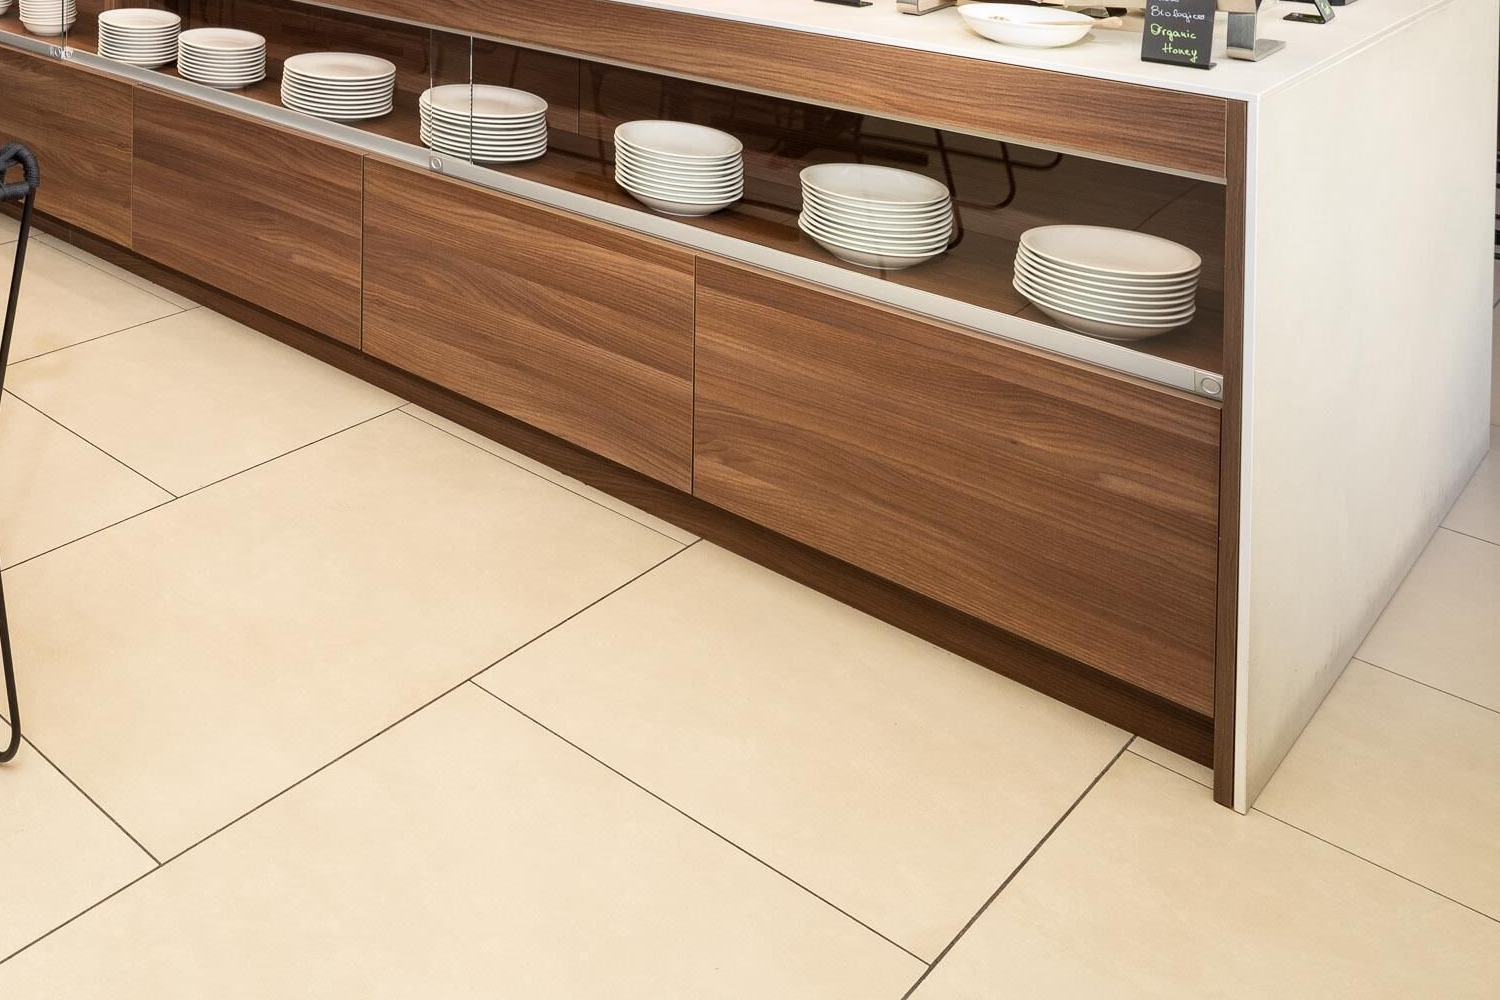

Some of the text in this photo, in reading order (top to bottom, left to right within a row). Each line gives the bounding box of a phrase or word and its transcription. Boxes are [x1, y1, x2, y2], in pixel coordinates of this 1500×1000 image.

[1150, 4, 1205, 23] Biologico
[1150, 23, 1197, 41] Organic
[1161, 42, 1198, 63] Honey
